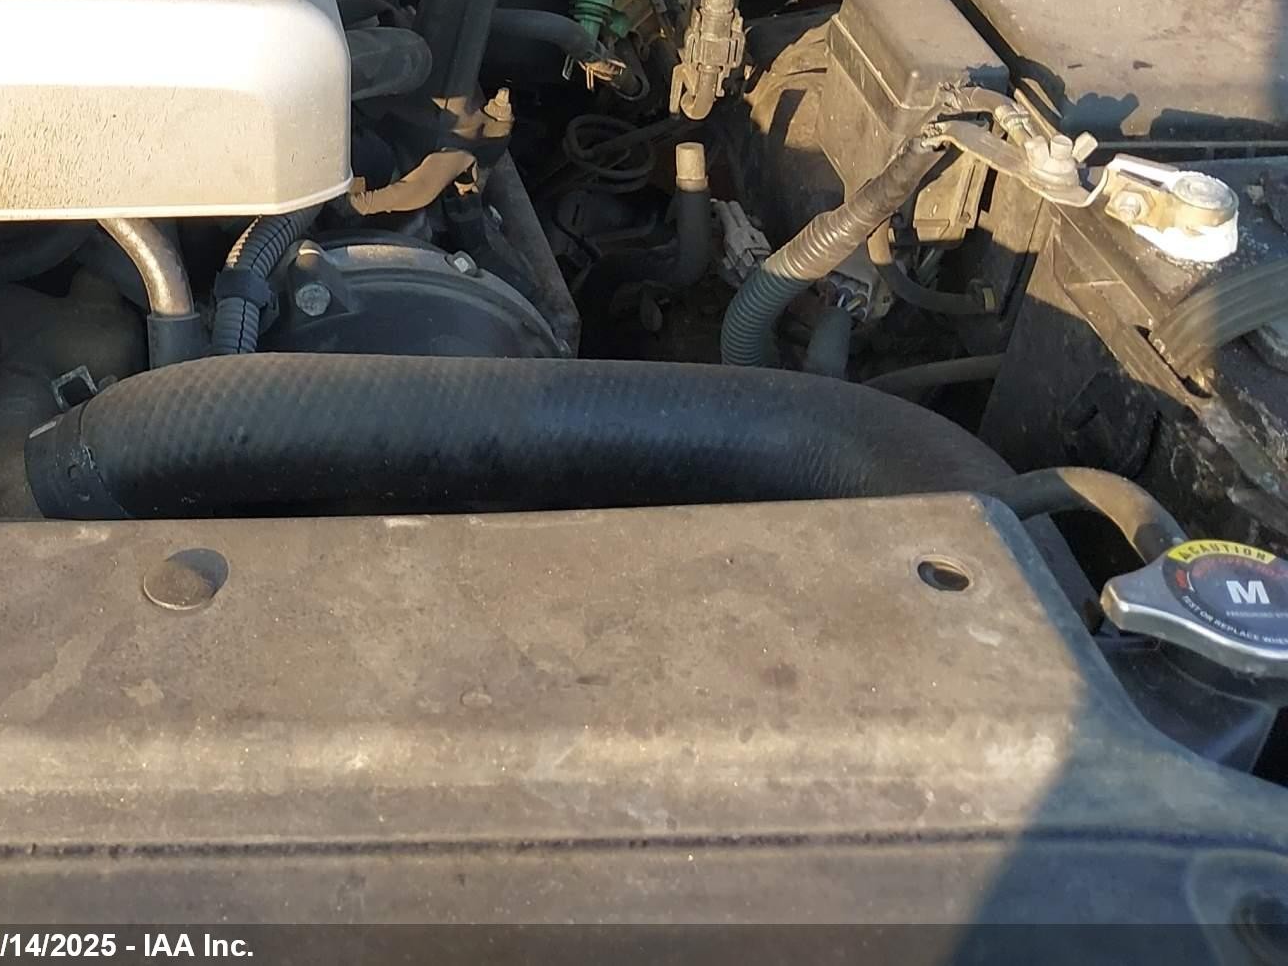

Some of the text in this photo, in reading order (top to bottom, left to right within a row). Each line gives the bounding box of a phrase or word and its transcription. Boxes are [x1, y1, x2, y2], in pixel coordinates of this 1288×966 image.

[1189, 543, 1267, 561] CAUTION
[1225, 580, 1270, 605] M
[1214, 619, 1260, 642] REPLACE
